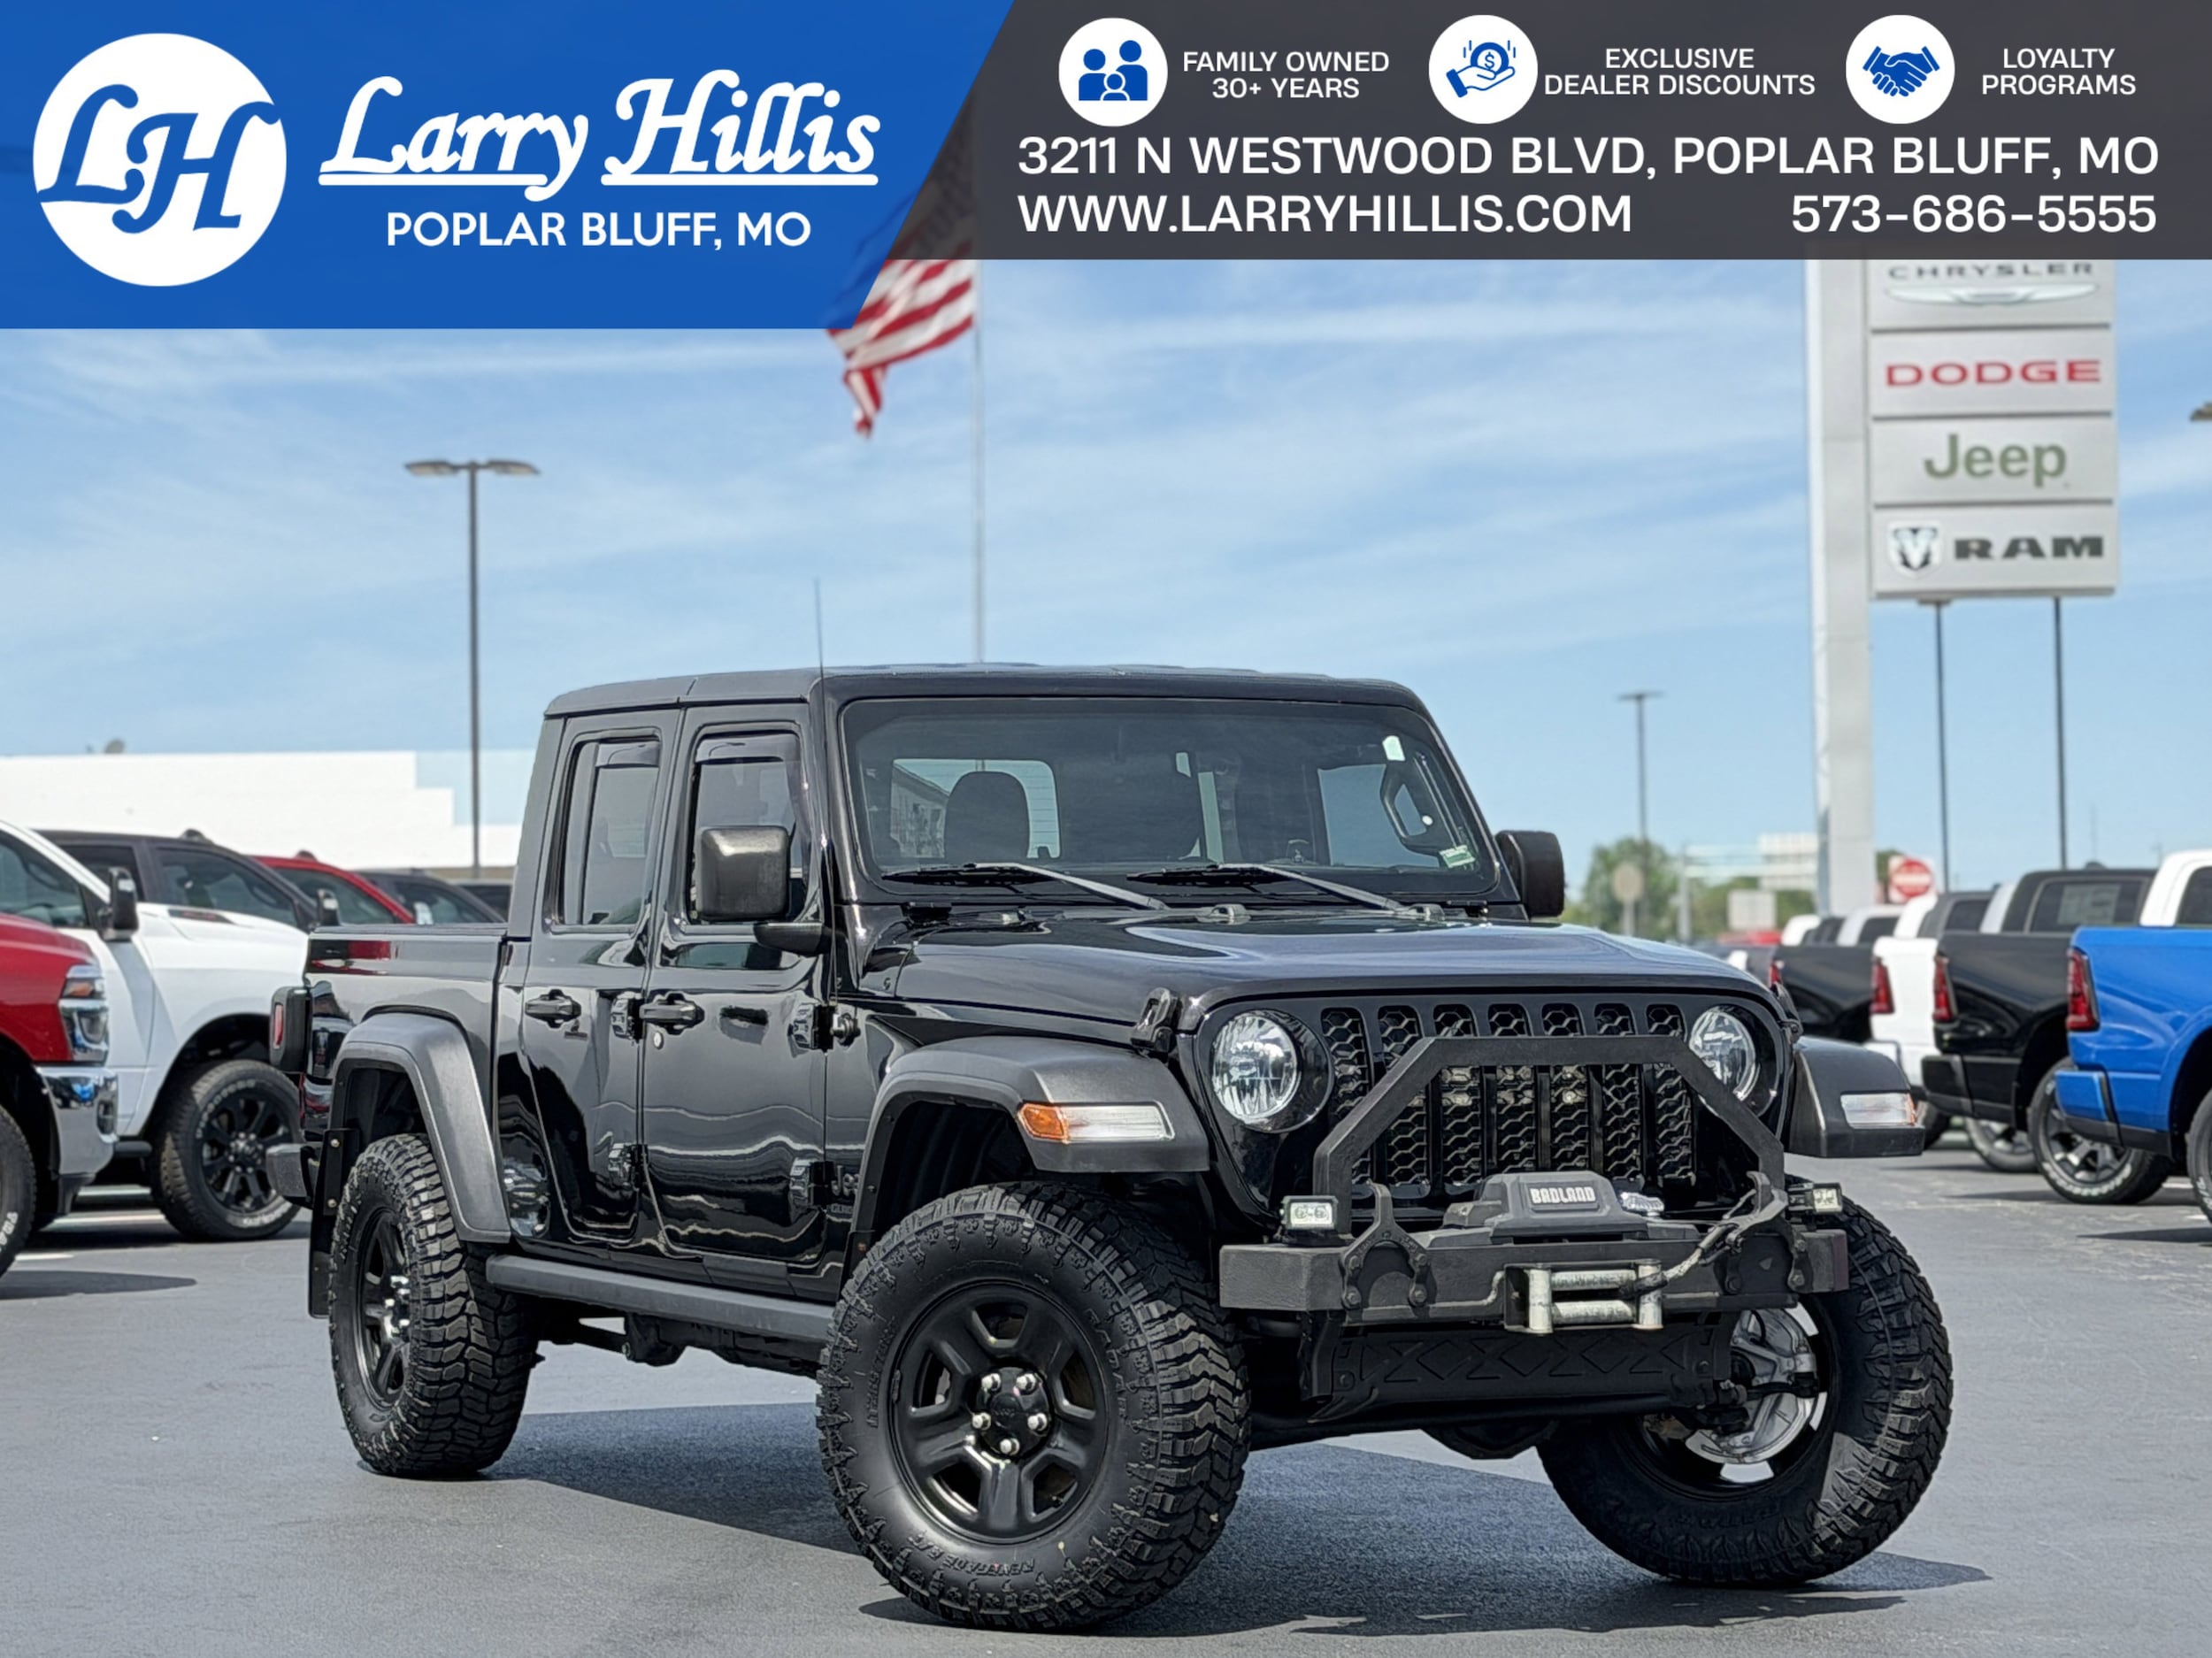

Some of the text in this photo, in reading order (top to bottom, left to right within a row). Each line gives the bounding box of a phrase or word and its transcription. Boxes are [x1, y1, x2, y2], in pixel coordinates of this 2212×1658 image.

[1888, 263, 2093, 279] CHRYSLER
[1886, 359, 2101, 387] DODGE
[1924, 433, 2067, 488] Jeep
[1954, 535, 2104, 561] RAM
[1530, 1186, 1597, 1204] BADLAND
